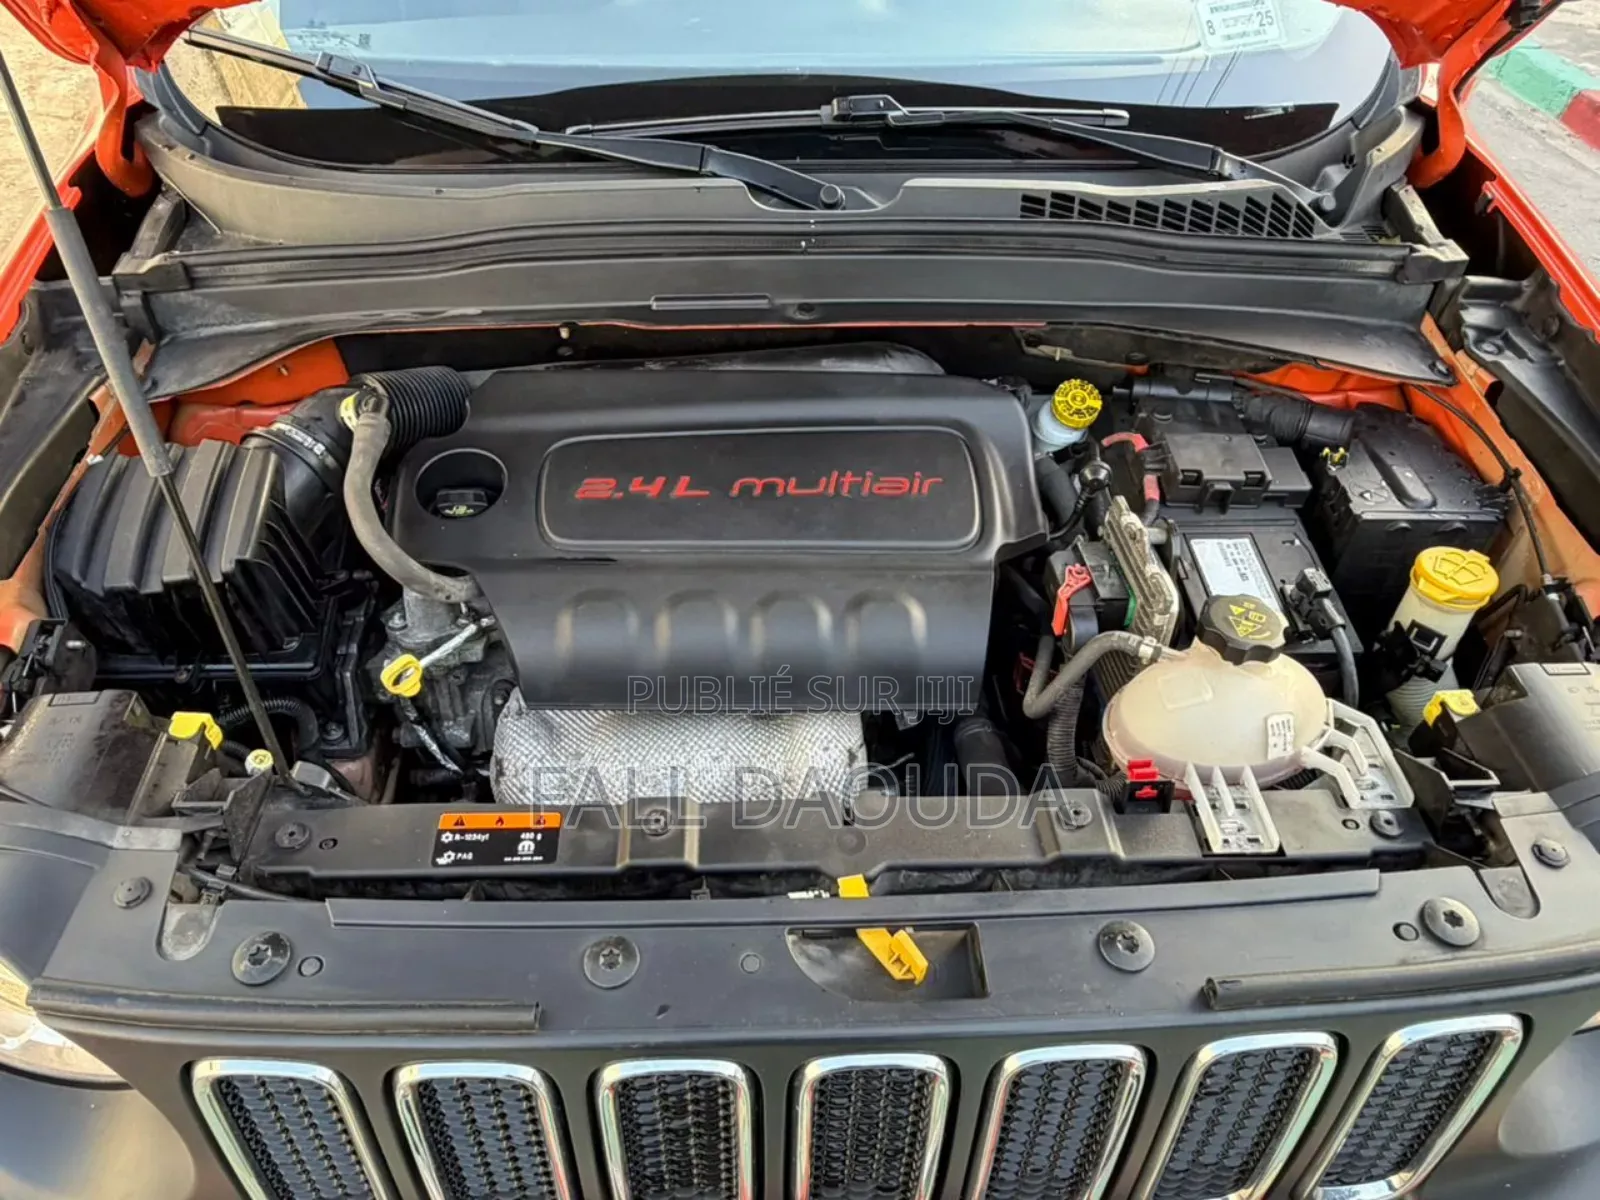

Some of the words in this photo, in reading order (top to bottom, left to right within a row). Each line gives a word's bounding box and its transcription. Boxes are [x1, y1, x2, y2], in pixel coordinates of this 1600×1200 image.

[1256, 10, 1274, 27] 25
[1206, 20, 1216, 36] 8
[729, 469, 943, 498] multiair
